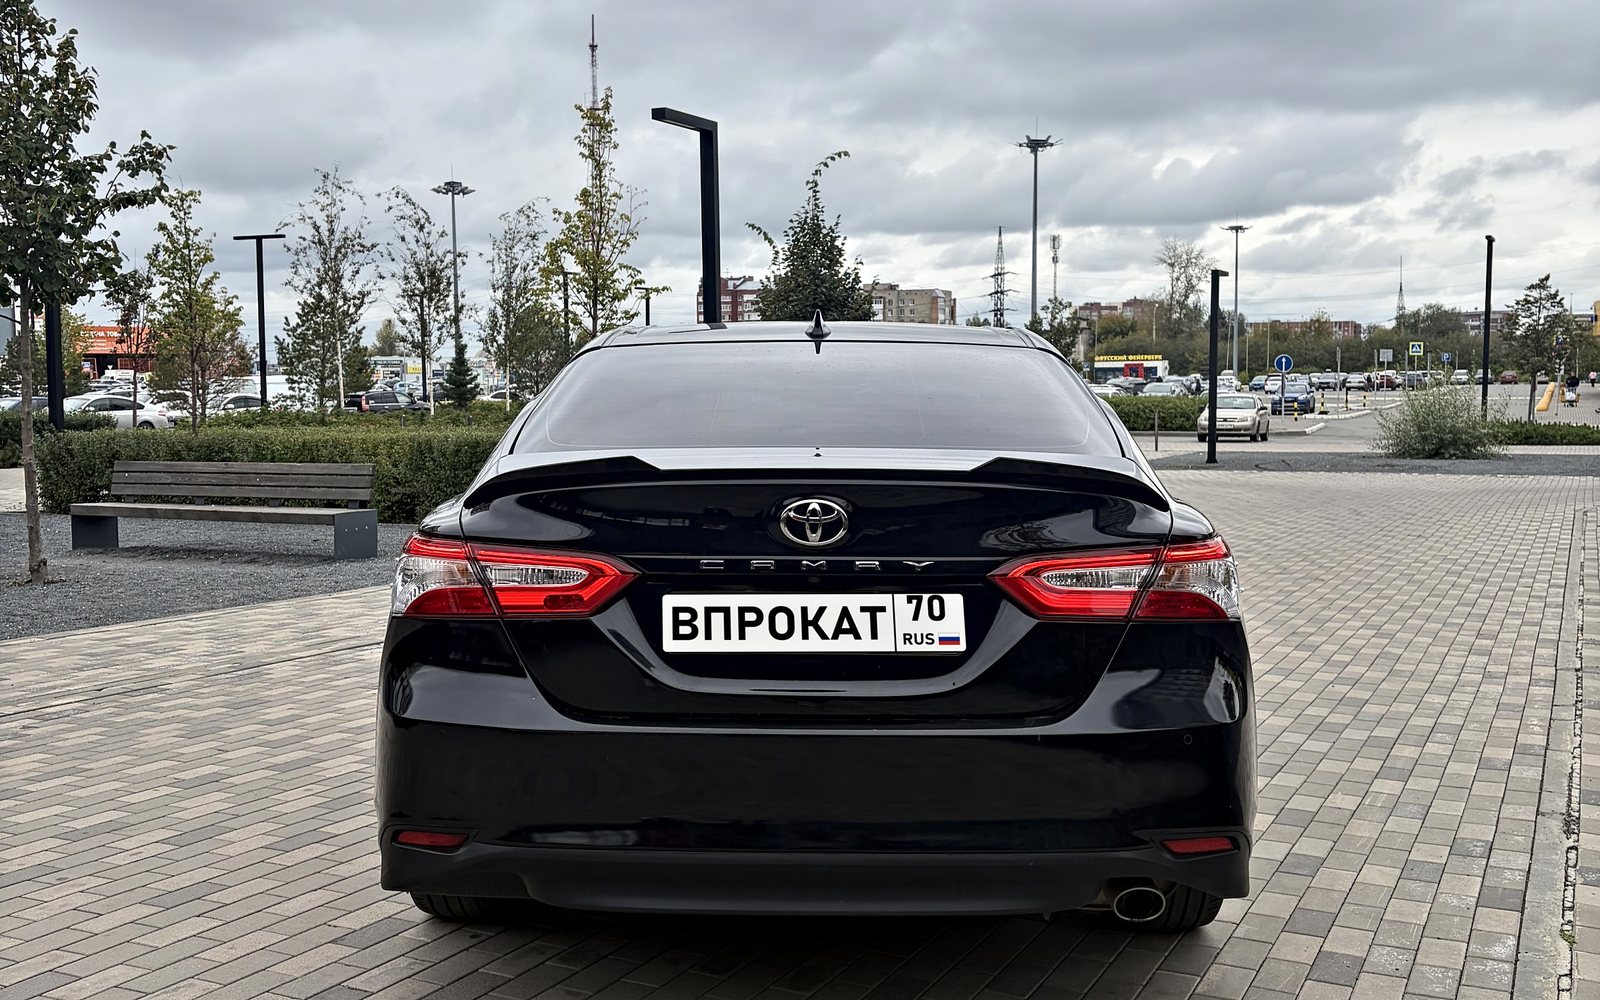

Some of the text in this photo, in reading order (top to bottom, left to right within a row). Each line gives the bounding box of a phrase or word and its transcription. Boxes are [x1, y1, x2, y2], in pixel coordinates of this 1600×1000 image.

[700, 560, 934, 571] CAMRY
[906, 594, 946, 622] 70
[672, 606, 886, 641] ВПРОКАТ
[903, 632, 935, 646] RUS
